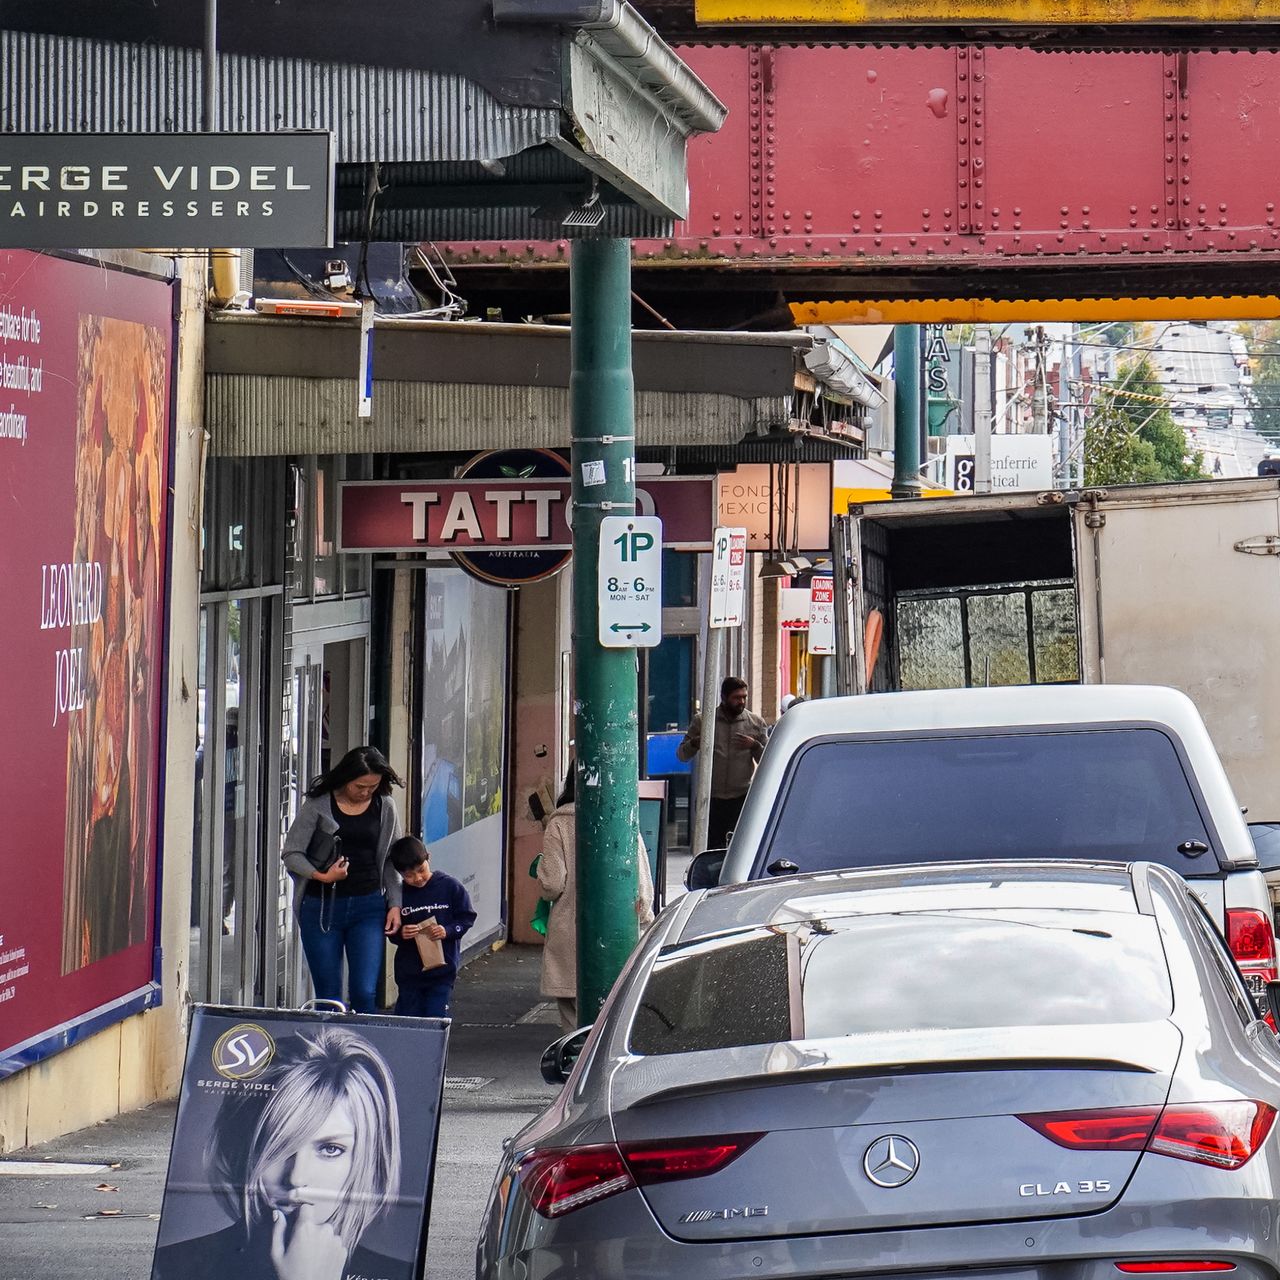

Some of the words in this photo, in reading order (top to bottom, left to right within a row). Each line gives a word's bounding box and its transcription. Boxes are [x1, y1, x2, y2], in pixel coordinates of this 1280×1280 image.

[154, 166, 311, 191] VIDEL
[11, 201, 274, 217] AIRDRESSERS
[720, 485, 785, 498] FONDA
[400, 486, 656, 540] TATT
[488, 550, 540, 559] AUSTRALIA
[613, 532, 654, 562] 1P
[813, 578, 833, 590] LOADING
[40, 562, 103, 630] LEONARD
[609, 594, 627, 602] MON
[634, 594, 650, 602] SAT
[815, 591, 830, 602] ZONE
[53, 647, 85, 727] JOEL
[401, 903, 450, 916] Champion
[217, 1033, 269, 1071] SV
[197, 1079, 239, 1089] SERGE
[242, 1082, 278, 1091] VIDEL
[1019, 1180, 1072, 1197] CLA
[1078, 1178, 1111, 1195] 35
